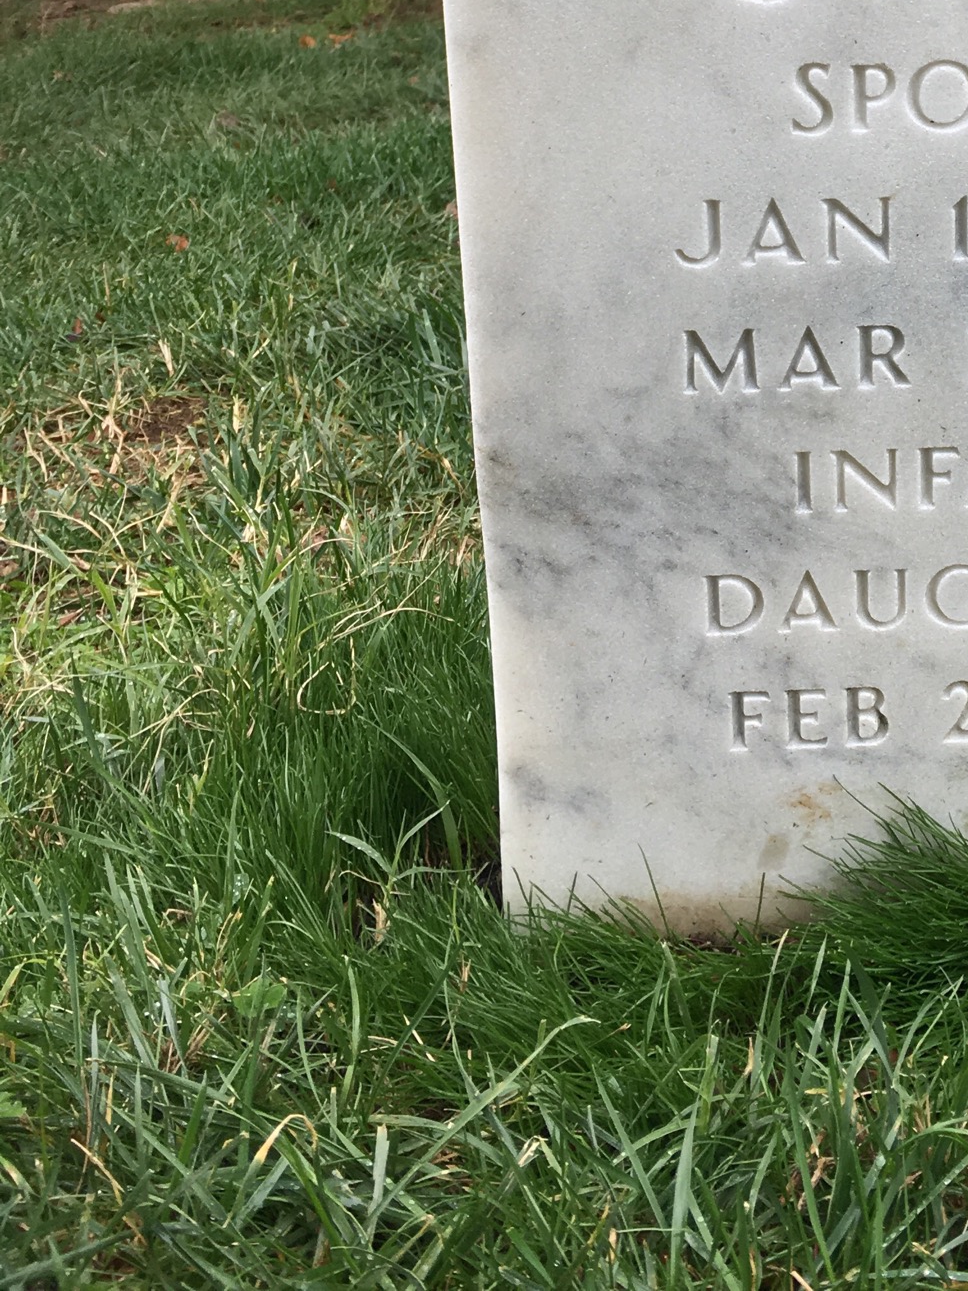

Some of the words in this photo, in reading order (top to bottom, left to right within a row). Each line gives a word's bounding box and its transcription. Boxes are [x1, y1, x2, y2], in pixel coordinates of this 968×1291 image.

[675, 196, 891, 268] JAN
[682, 324, 912, 394] MAR
[728, 685, 890, 751] FEB
